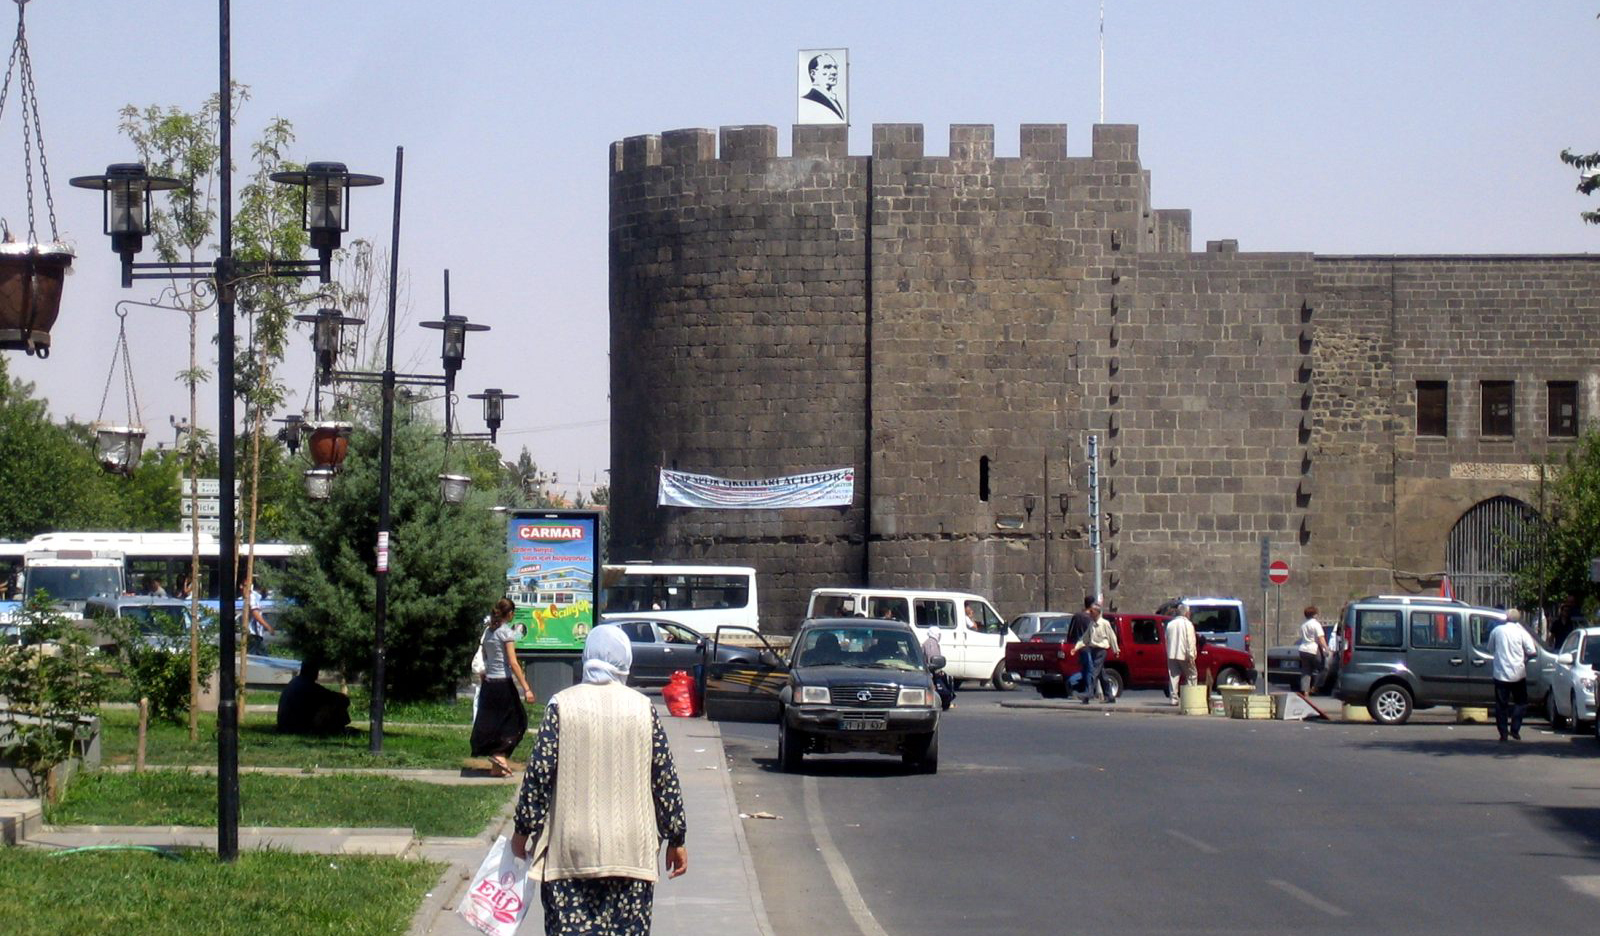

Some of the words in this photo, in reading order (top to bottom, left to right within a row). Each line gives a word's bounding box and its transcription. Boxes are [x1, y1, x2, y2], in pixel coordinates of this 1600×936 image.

[520, 527, 582, 538] CARMAR
[1019, 653, 1044, 661] TOYOTA
[475, 879, 520, 911] Elif
